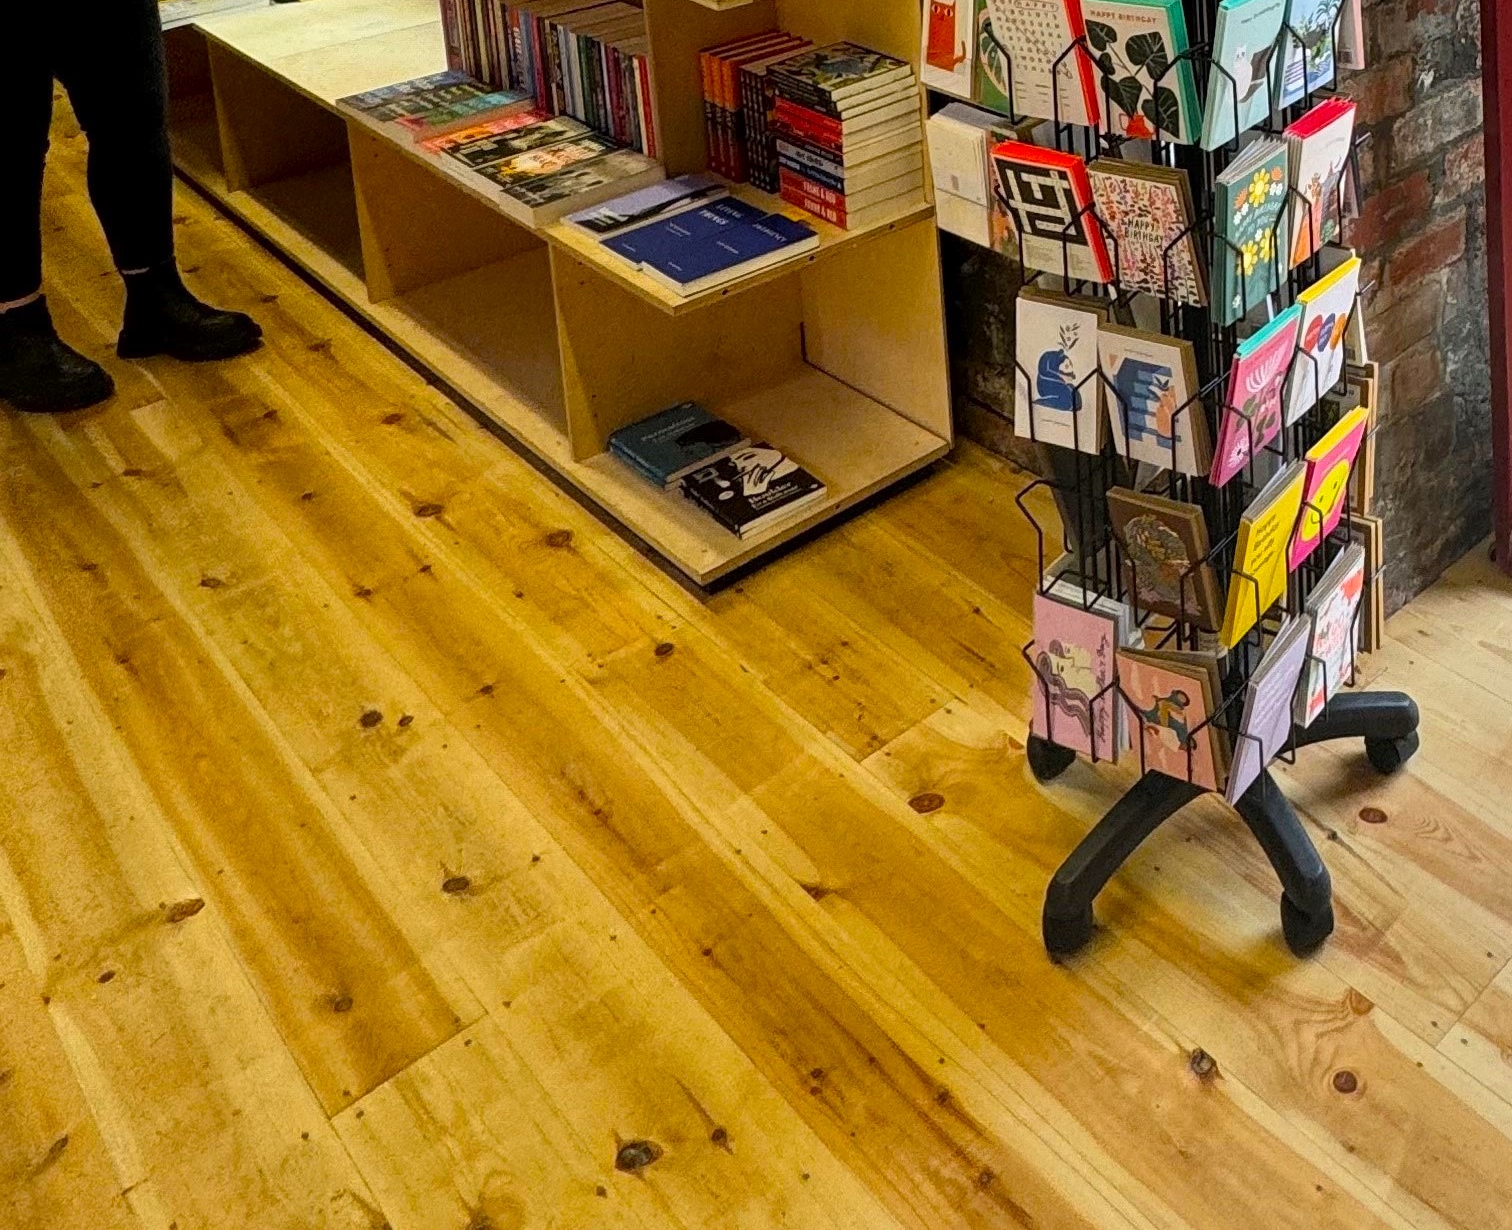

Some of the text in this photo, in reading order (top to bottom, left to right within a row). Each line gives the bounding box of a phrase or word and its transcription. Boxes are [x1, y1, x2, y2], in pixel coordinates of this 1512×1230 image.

[1090, 9, 1156, 24] HAPPY BIRTHDAY
[1128, 218, 1155, 231] HAPPY
